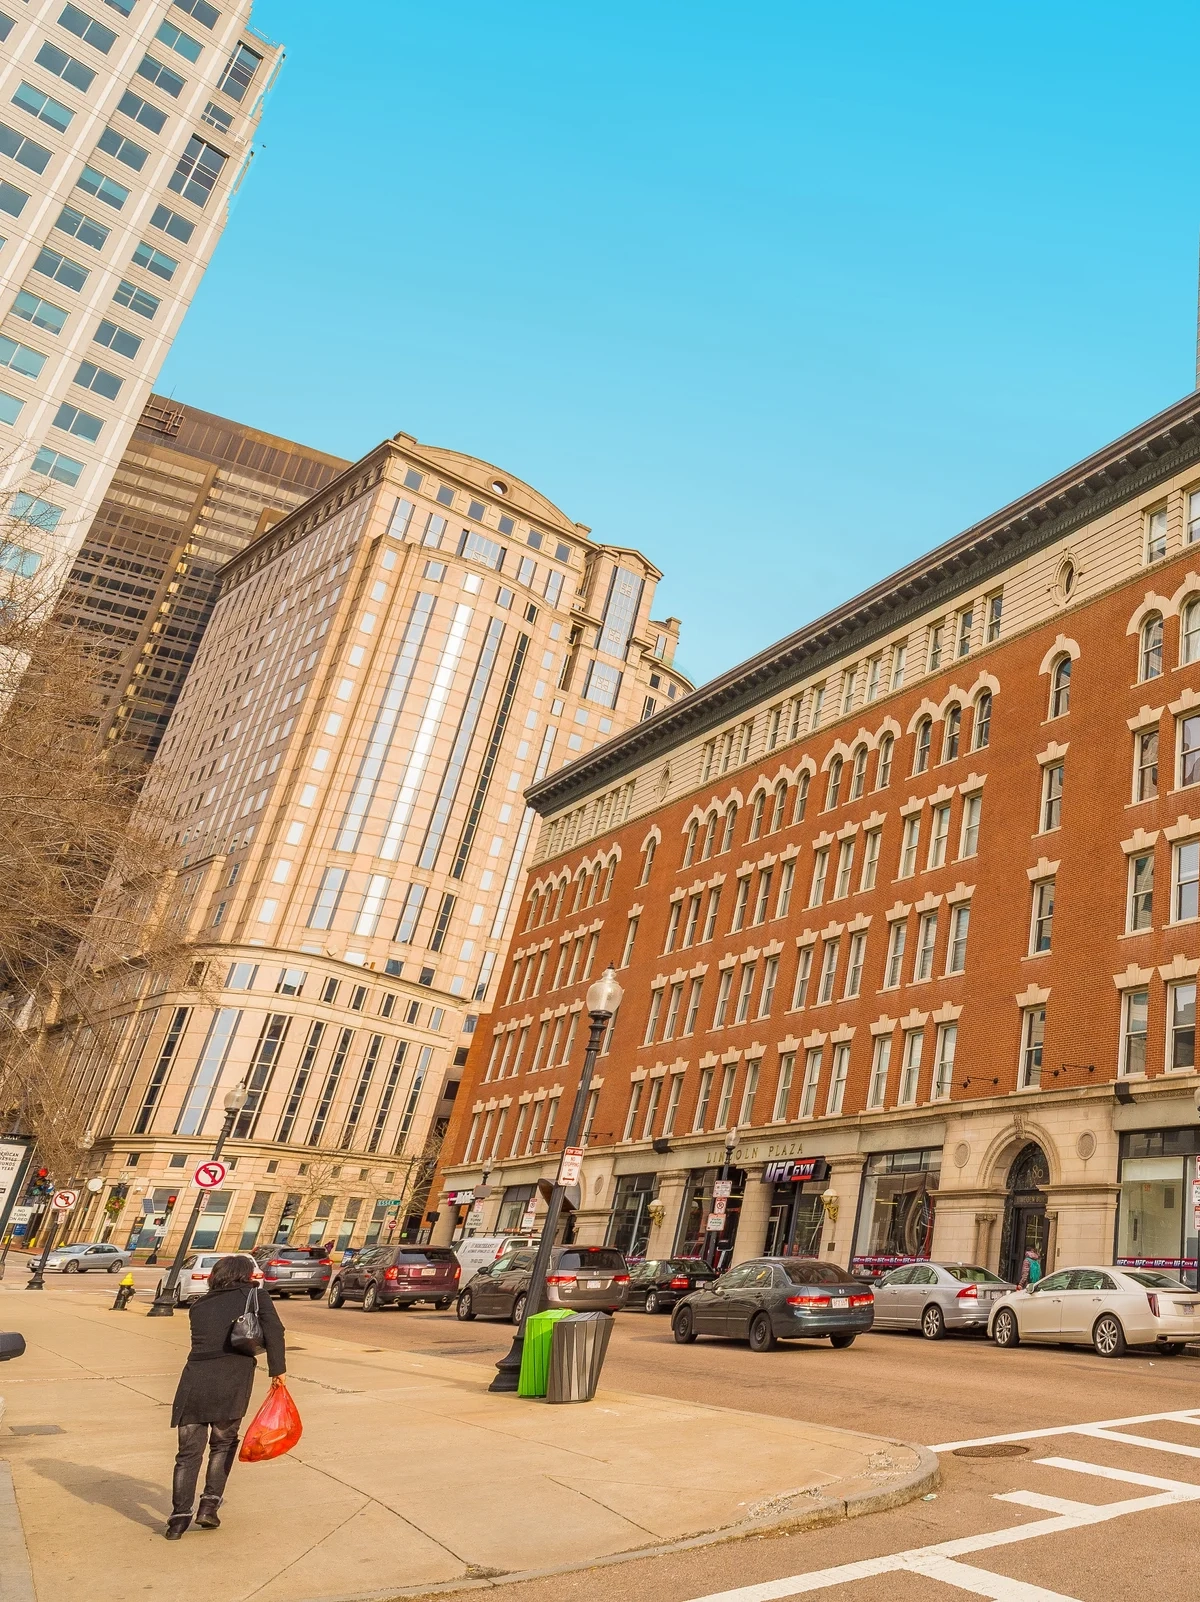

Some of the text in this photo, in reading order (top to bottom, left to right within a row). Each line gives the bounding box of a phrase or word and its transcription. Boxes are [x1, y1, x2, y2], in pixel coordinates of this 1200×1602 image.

[706, 1143, 804, 1164] LINOLN PLAZA
[764, 1160, 815, 1182] UFC GYM
[1032, 1165, 1044, 1178] 80
